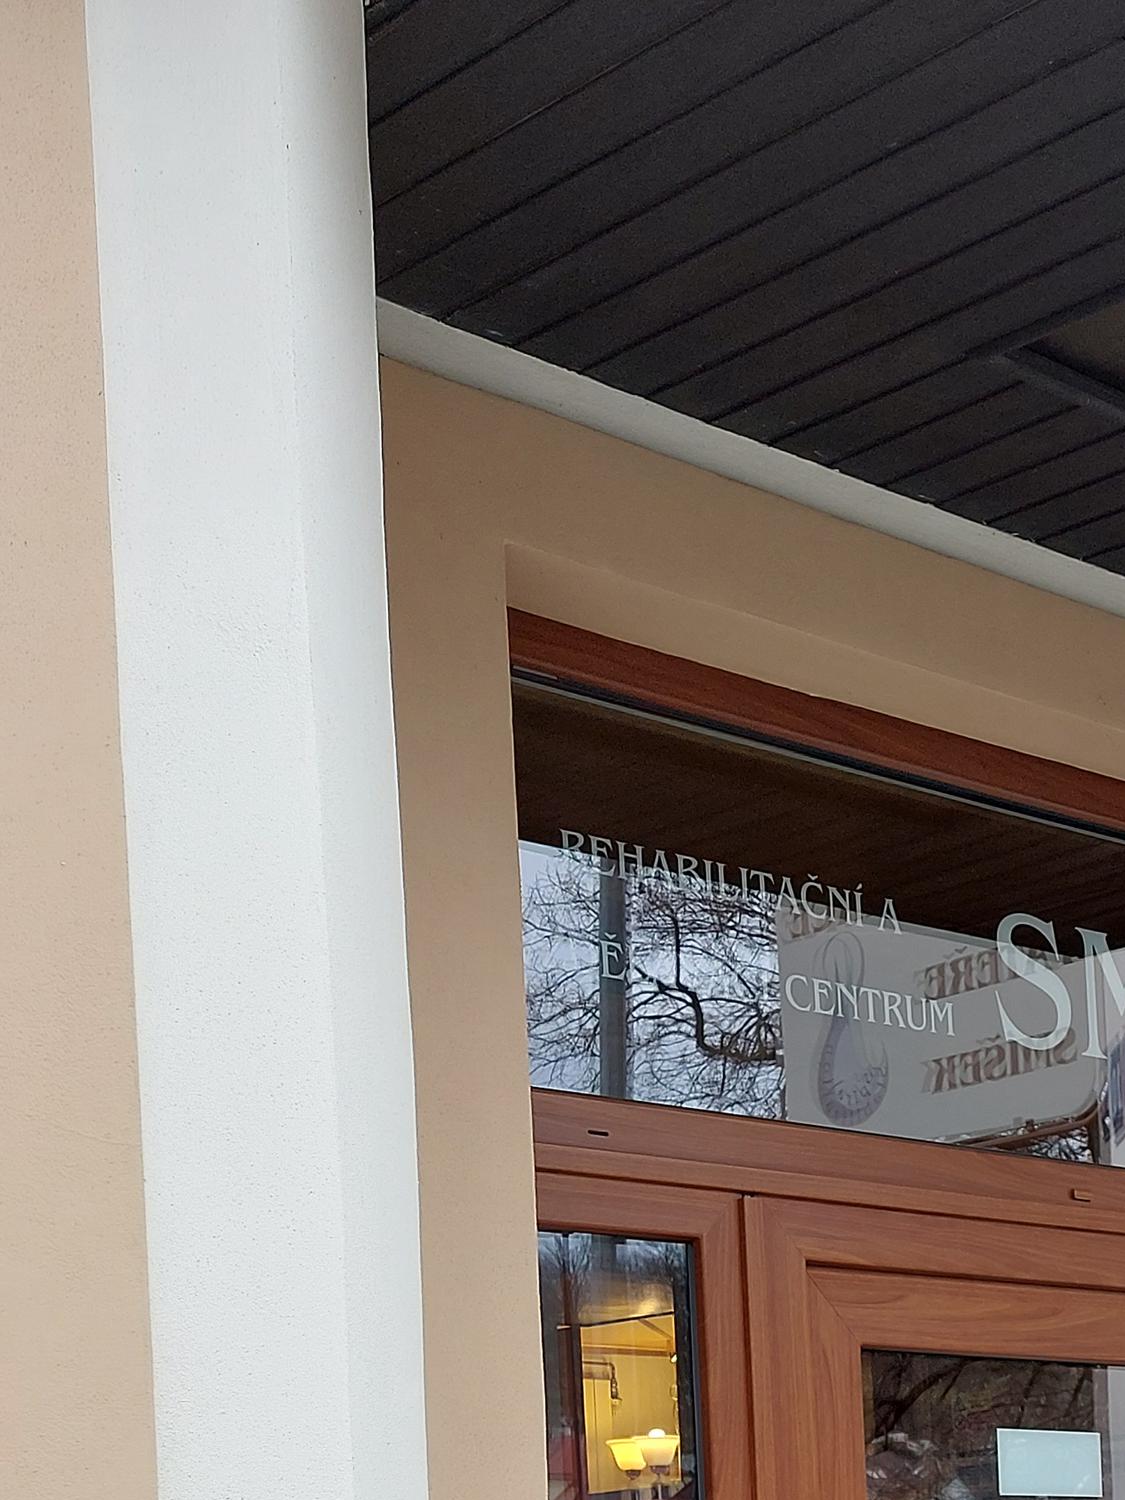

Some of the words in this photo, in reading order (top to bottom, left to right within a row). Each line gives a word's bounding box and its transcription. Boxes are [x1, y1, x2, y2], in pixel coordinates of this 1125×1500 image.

[560, 828, 865, 927] REHABILITAČNÍ
[878, 897, 903, 935] A
[785, 974, 956, 1037] CENTRUM
